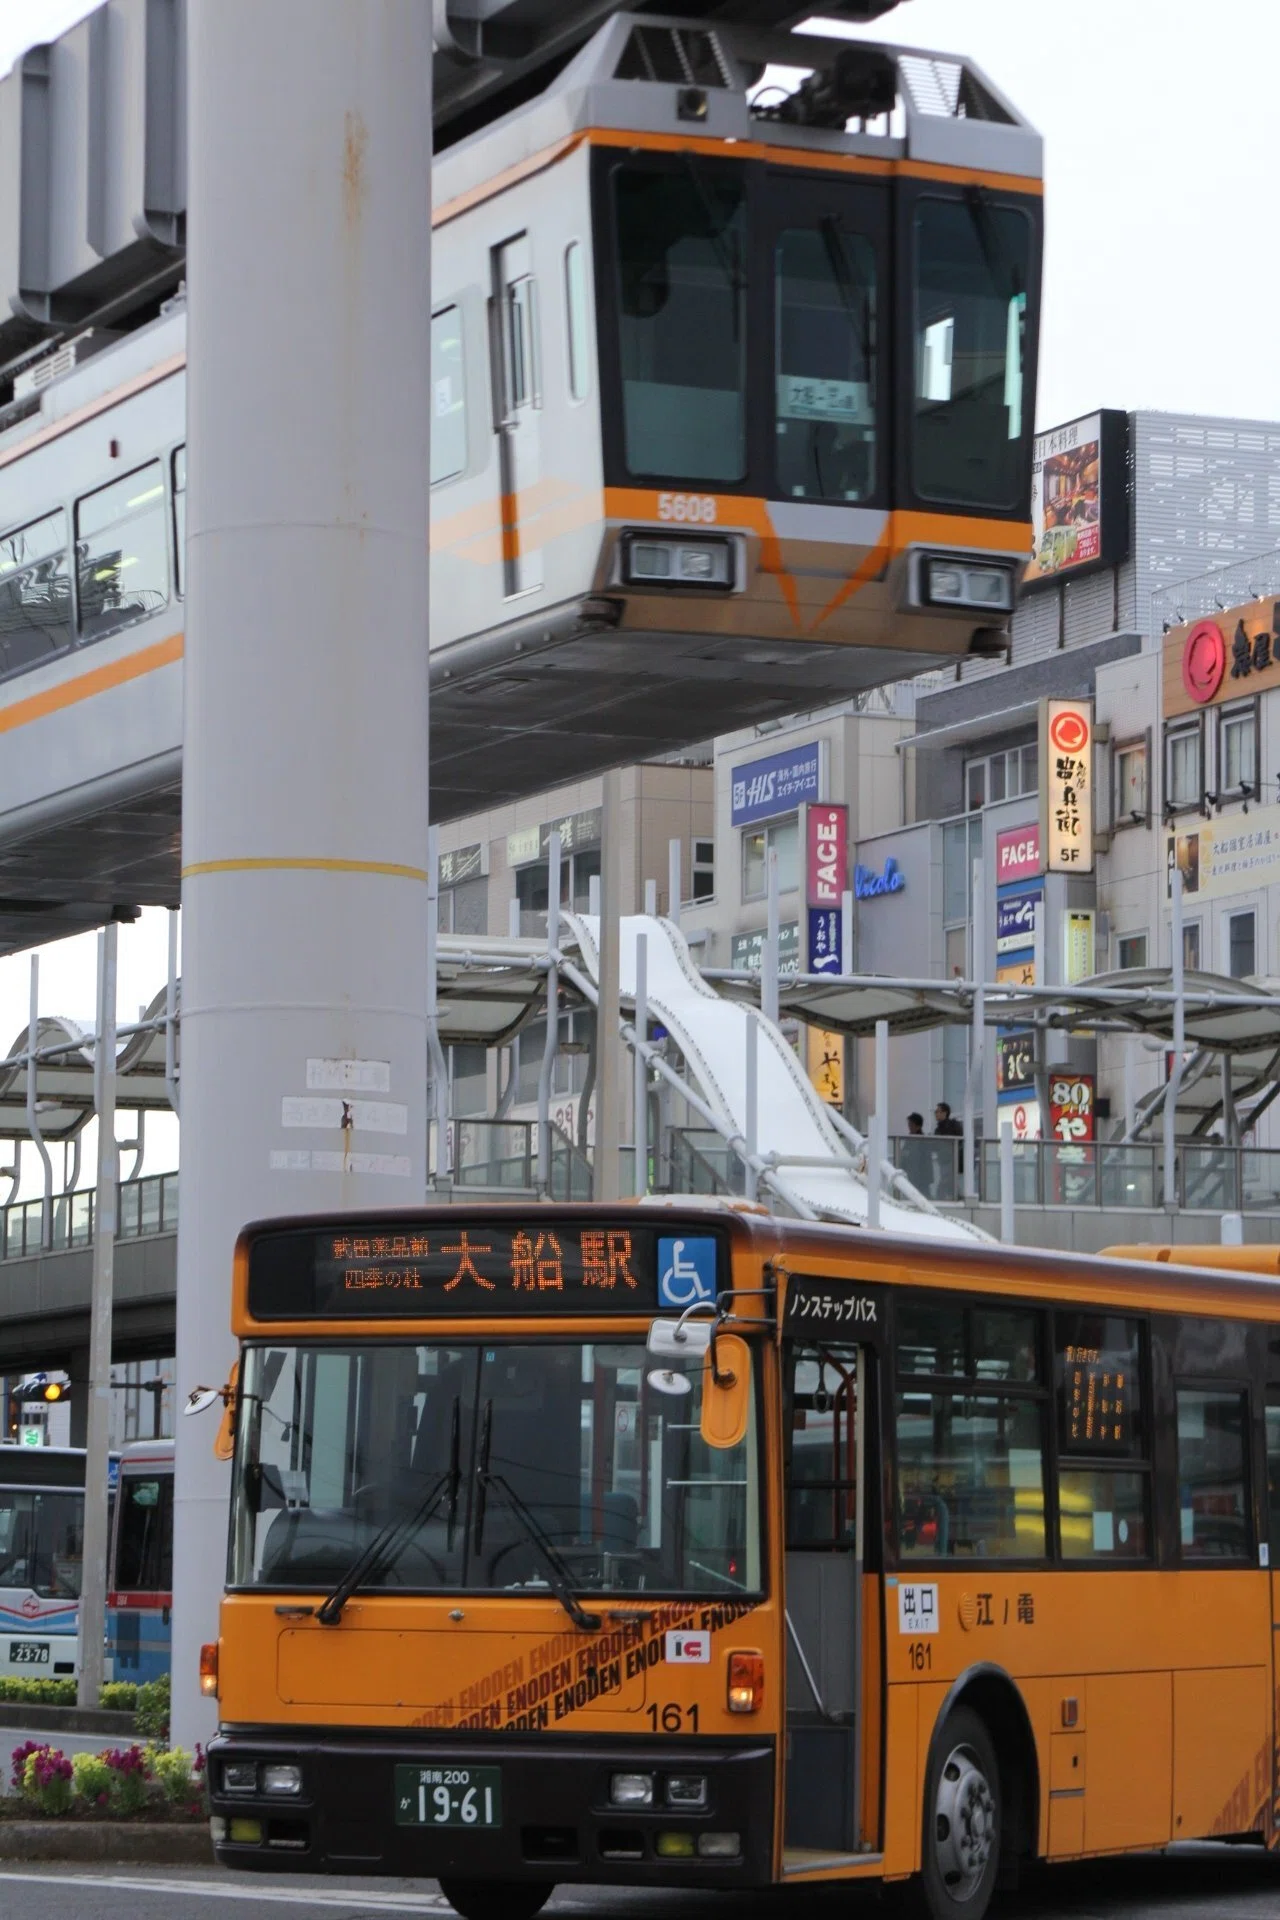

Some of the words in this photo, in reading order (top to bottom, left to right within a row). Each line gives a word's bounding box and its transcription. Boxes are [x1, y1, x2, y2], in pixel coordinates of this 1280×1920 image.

[658, 493, 716, 523] 5608
[1060, 850, 1079, 862] 5F
[1053, 1082, 1091, 1105] 80
[333, 1236, 429, 1259] 武田薬品前
[441, 1231, 637, 1291] 大船駅
[790, 1293, 877, 1322] ノンステップバス
[903, 1587, 933, 1616] 出口
[976, 1592, 1035, 1626] 江ノ電
[908, 1617, 929, 1630] EXIT
[909, 1641, 932, 1671] 161
[507, 1658, 571, 1719] ENODEN
[555, 1661, 620, 1720] ENODEN
[646, 1702, 699, 1734] 161
[420, 1769, 443, 1784] 湘南
[444, 1770, 470, 1785] 200
[418, 1785, 493, 1824] 19-61
